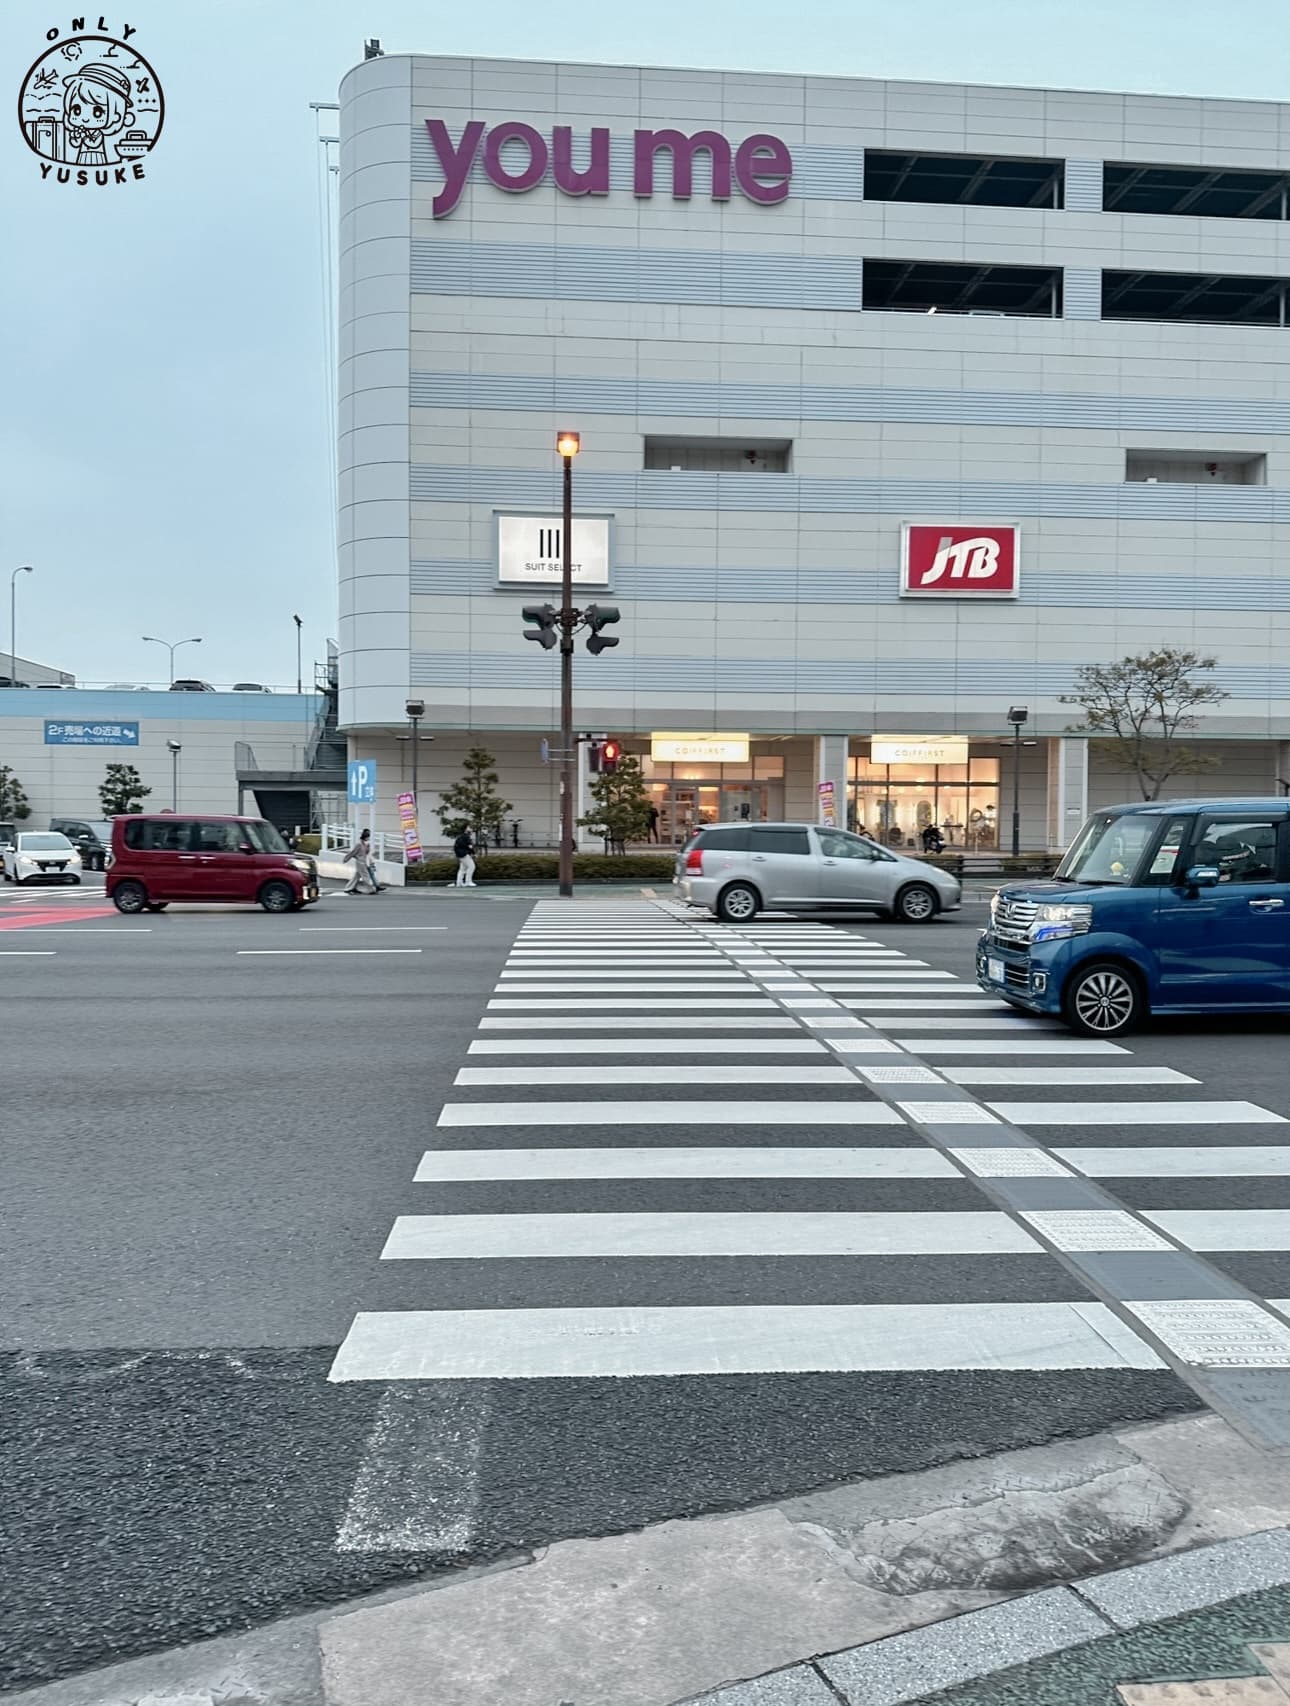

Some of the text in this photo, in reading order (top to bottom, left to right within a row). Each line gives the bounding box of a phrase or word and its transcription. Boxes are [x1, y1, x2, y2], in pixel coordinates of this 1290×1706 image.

[525, 562, 583, 572] SUIT SELCT
[920, 536, 1001, 585] JTB
[358, 765, 368, 799] P
